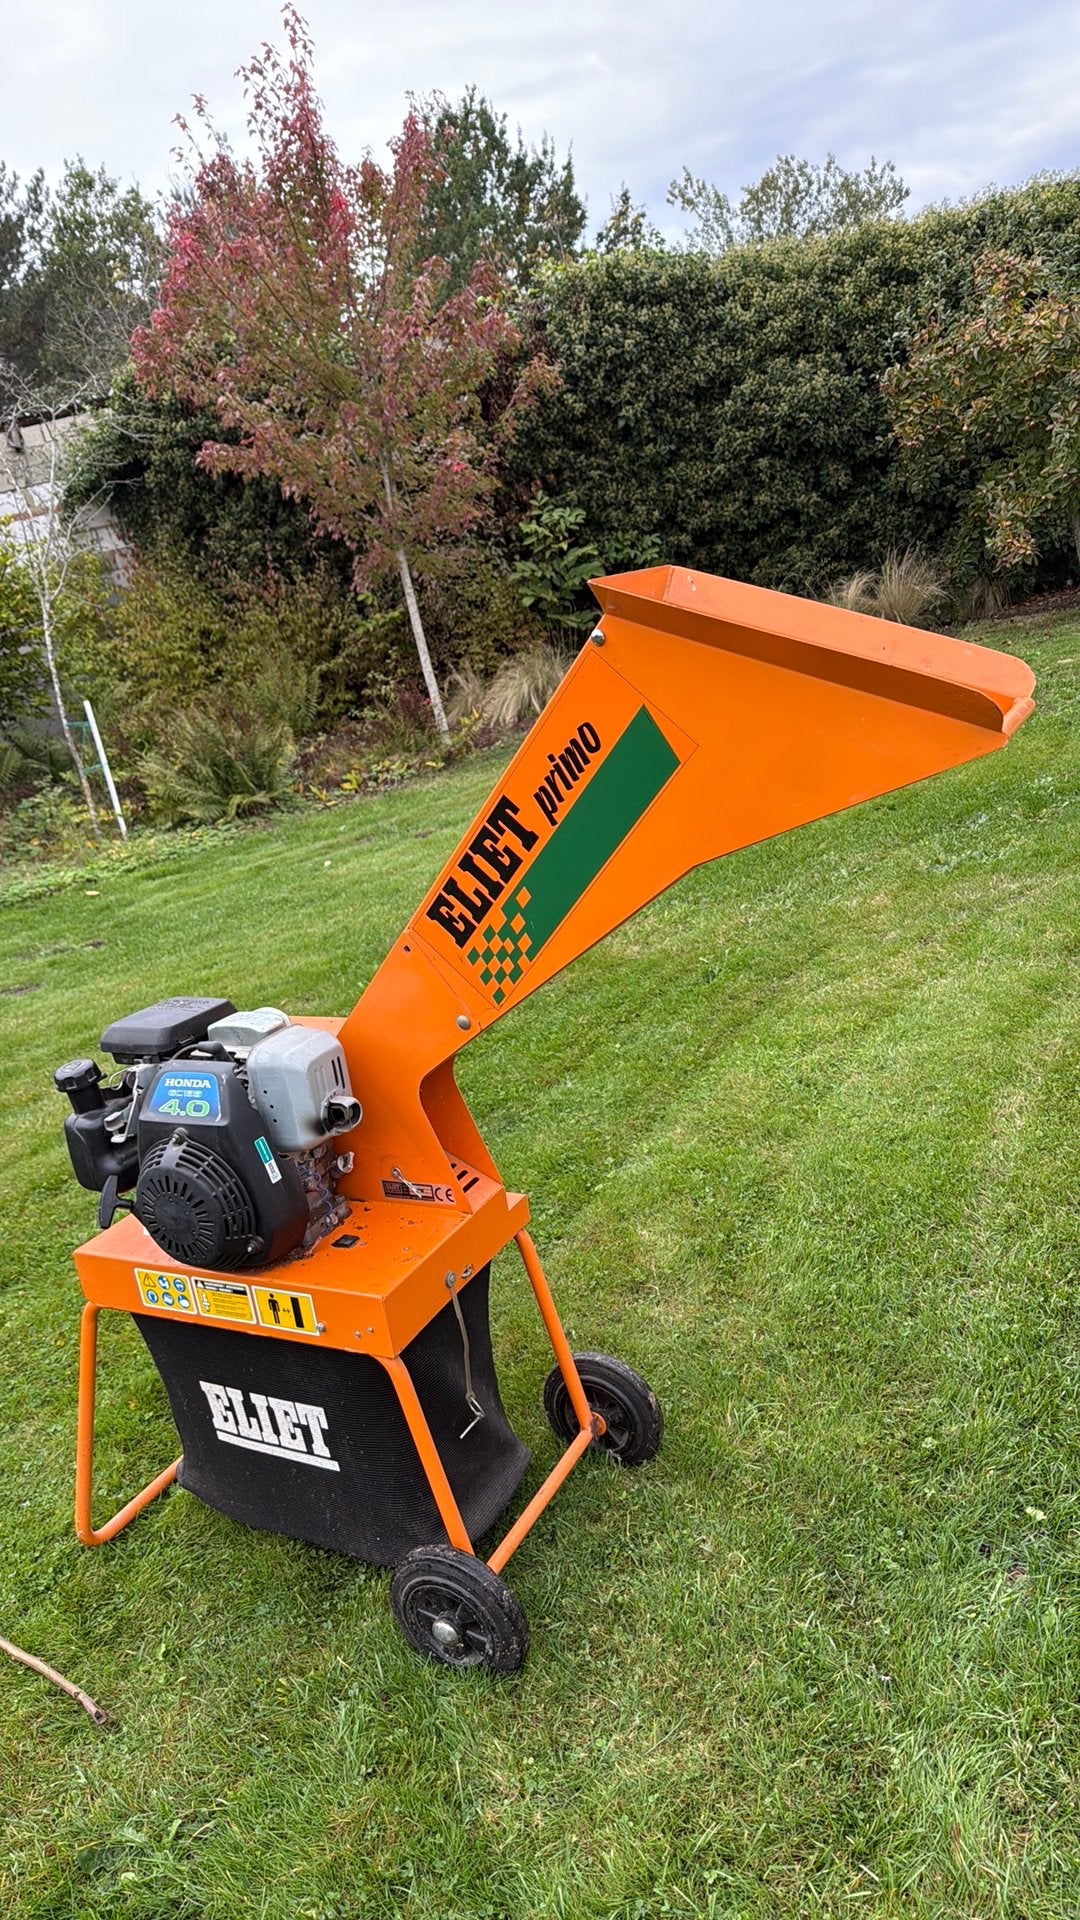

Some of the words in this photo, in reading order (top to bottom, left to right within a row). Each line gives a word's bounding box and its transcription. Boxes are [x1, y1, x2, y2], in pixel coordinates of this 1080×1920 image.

[425, 794, 540, 950] ELIET
[532, 721, 602, 827] primo
[158, 1098, 210, 1117] 4.0
[164, 1078, 211, 1089] HONDA
[199, 1380, 332, 1458] ELIET
